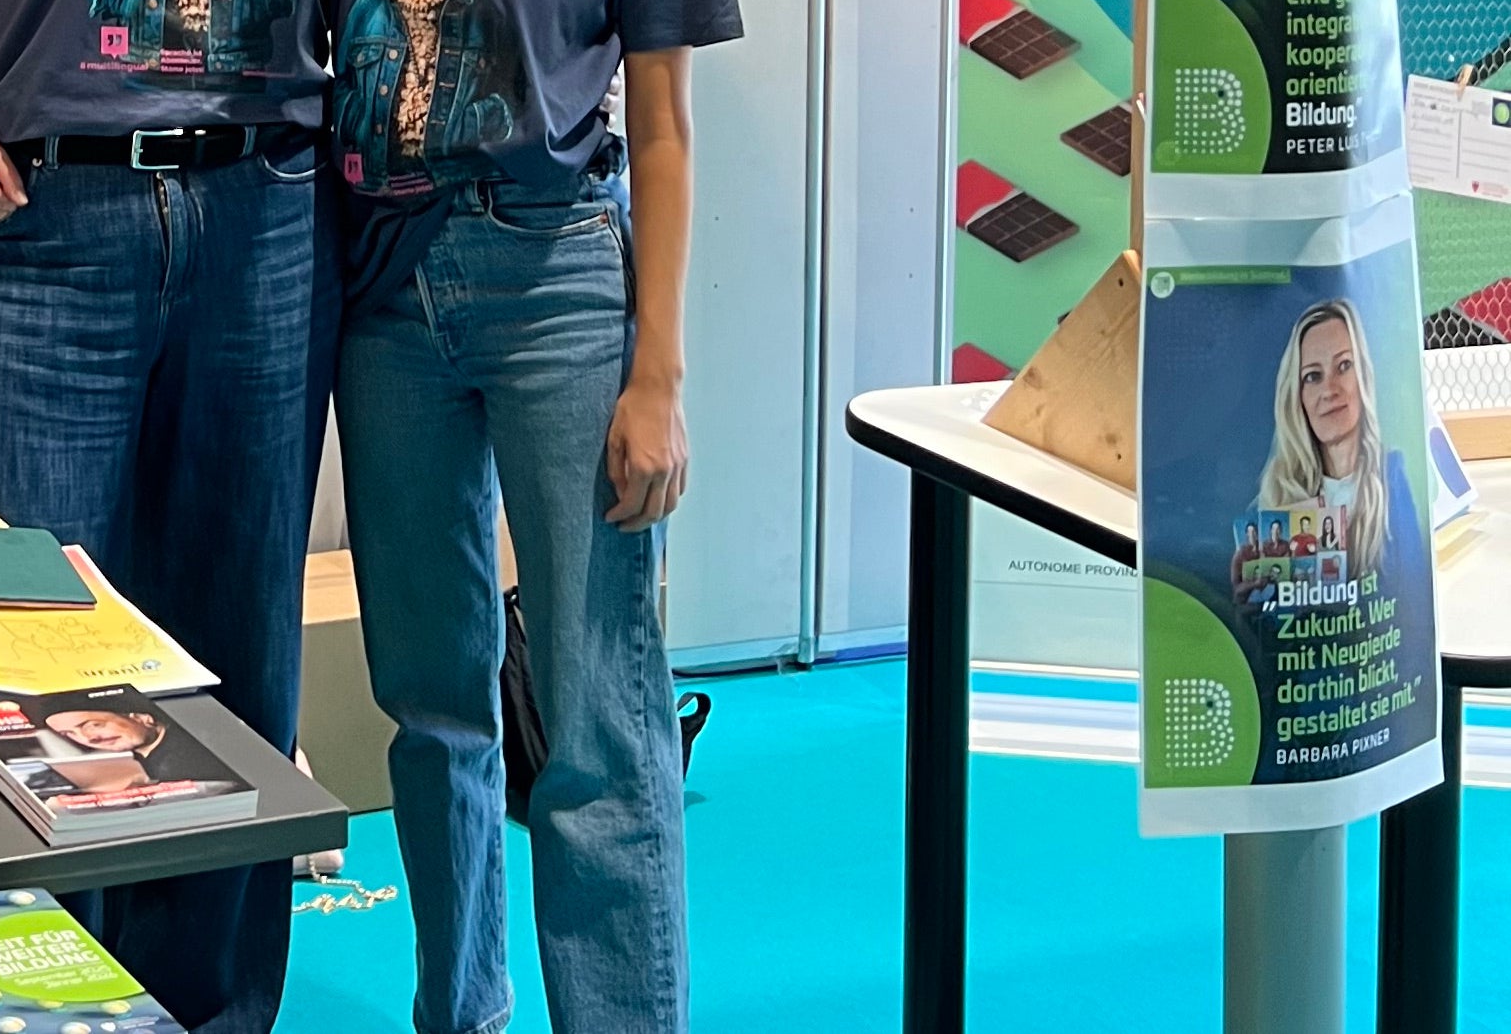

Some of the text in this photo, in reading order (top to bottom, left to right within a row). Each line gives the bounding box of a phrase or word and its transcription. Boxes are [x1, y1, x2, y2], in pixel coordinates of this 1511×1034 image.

[1286, 137, 1334, 155] PETER
[1008, 560, 1081, 575] AUTONOME
[1361, 569, 1378, 595] ist
[1277, 597, 1396, 639] Zukunft. Wer
[1278, 625, 1401, 671] mit Neugierde
[1277, 658, 1399, 703] dorthin blickt,
[1277, 701, 1367, 742] gestaltet
[1370, 693, 1389, 720] sie
[1276, 728, 1391, 765] BARBARA PIXNER
[29, 929, 81, 946] FÜR
